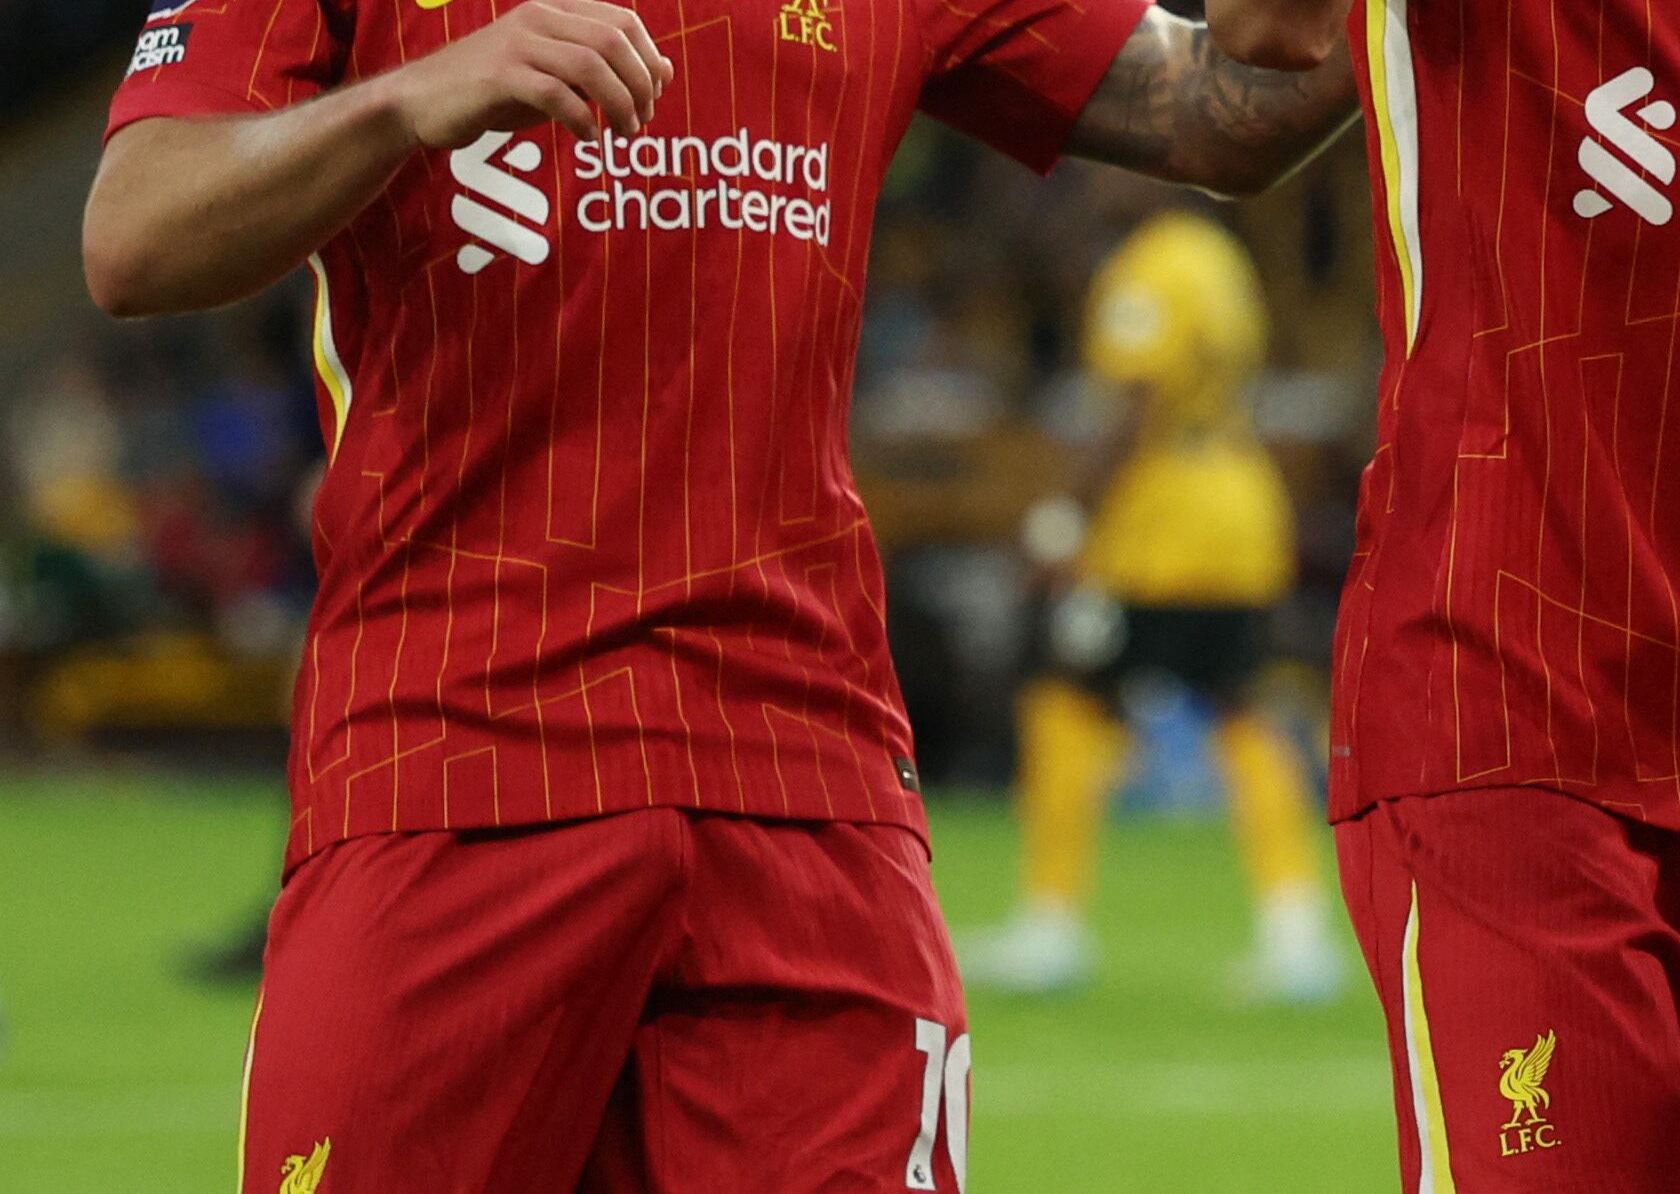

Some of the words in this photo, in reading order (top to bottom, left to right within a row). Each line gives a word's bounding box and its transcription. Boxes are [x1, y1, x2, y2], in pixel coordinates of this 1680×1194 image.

[573, 127, 828, 192] standard
[576, 179, 831, 247] chartered
[1499, 1123, 1563, 1157] L.F.C.
